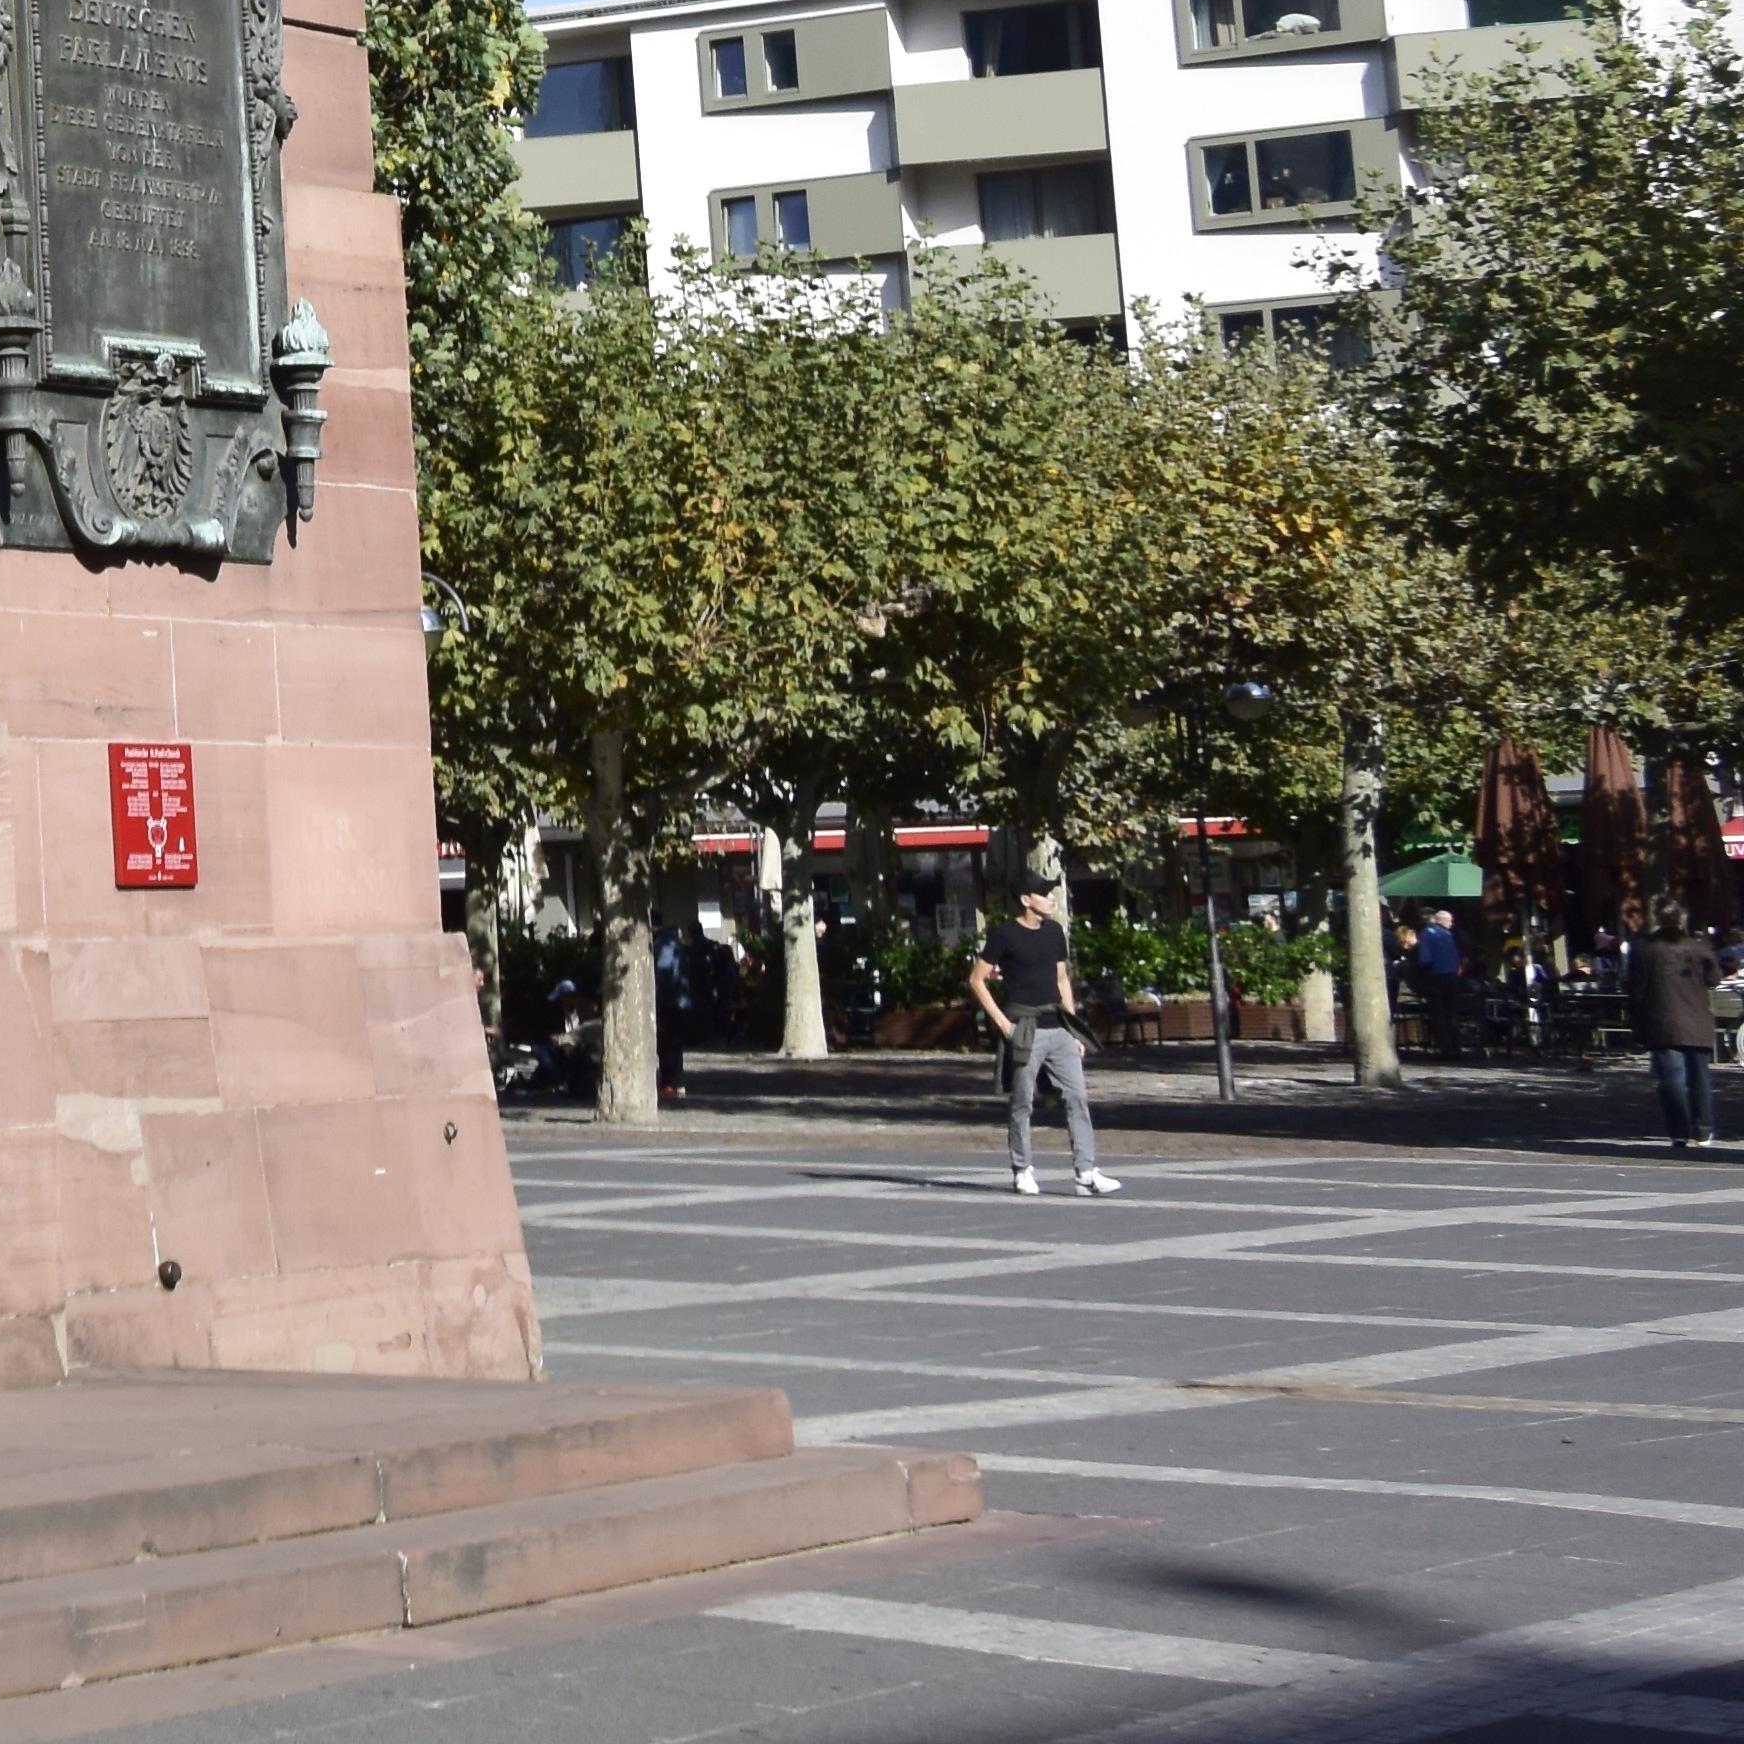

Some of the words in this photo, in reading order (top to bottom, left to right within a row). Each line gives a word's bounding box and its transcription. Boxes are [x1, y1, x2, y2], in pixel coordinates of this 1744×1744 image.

[57, 33, 209, 85] PARLAMENTS
[103, 82, 172, 114] WURDEN
[48, 102, 98, 130] DIESE
[102, 111, 224, 150] GEDENKTAFELN
[104, 139, 138, 165] VON
[141, 147, 175, 172] DER
[56, 164, 103, 190] STADT
[109, 170, 202, 204] FRANKFURT
[100, 198, 186, 230] GESTIFTET
[88, 226, 114, 250] AM
[134, 231, 165, 257] MAI
